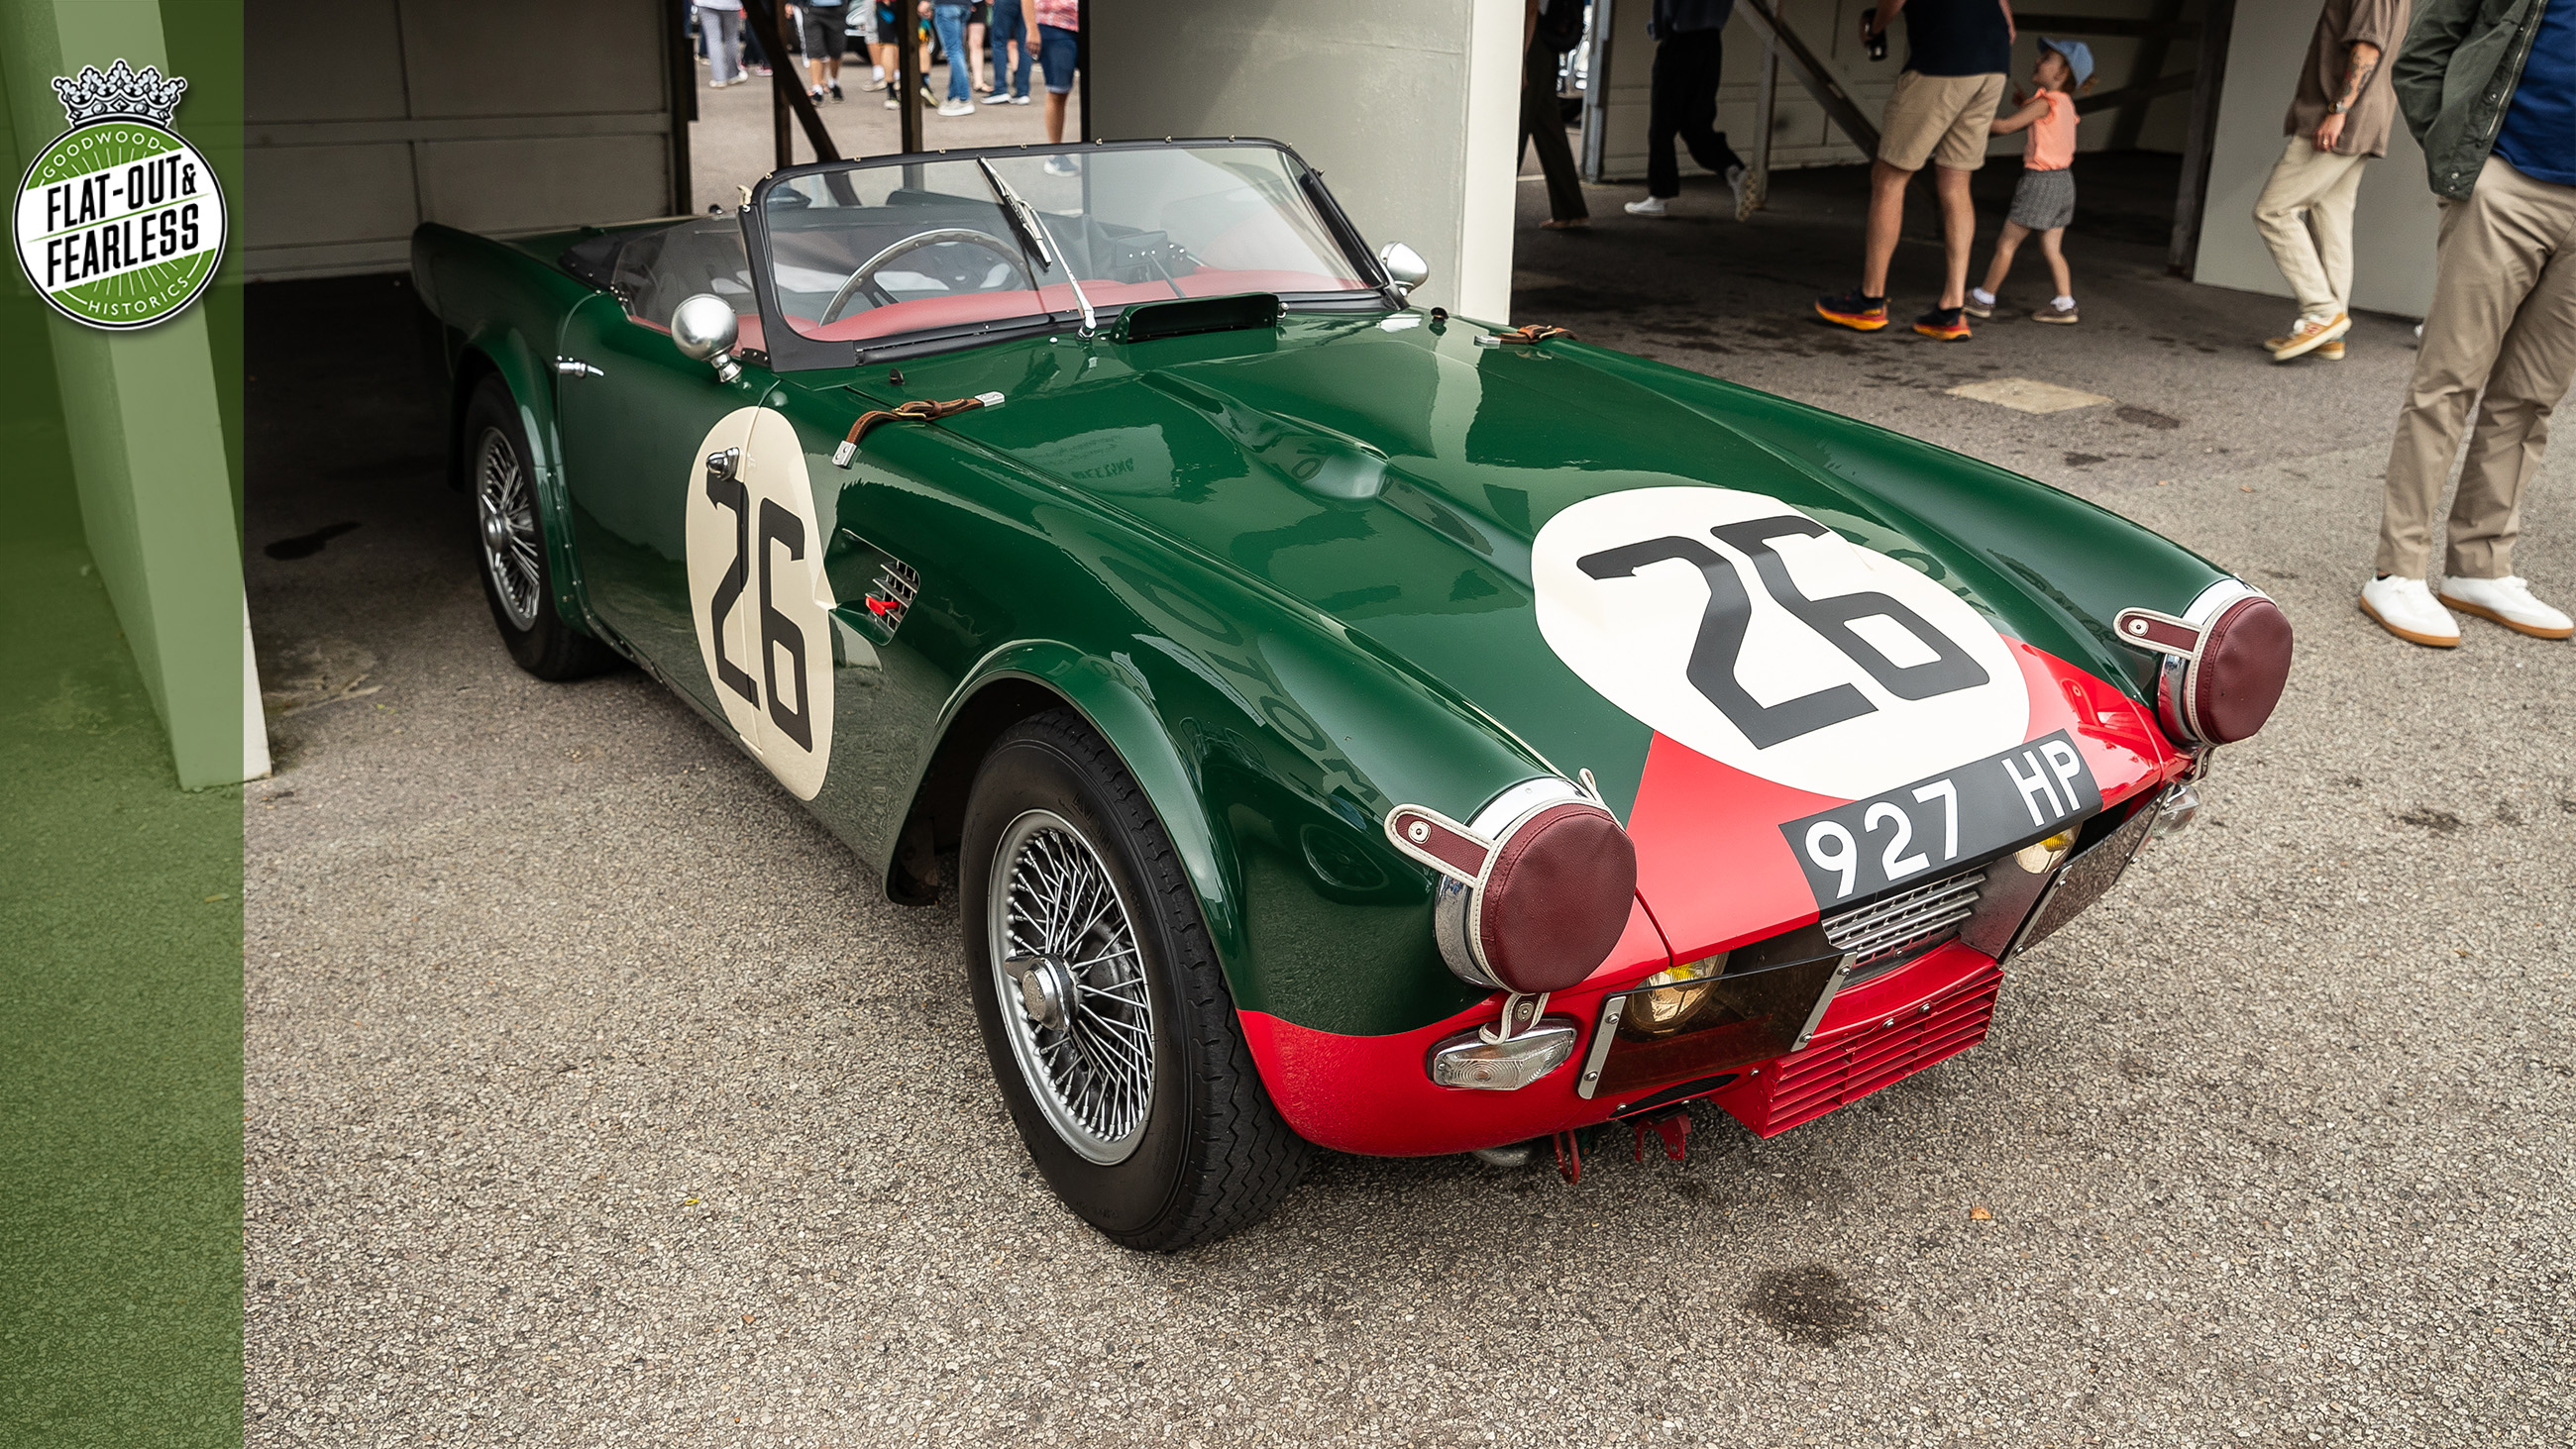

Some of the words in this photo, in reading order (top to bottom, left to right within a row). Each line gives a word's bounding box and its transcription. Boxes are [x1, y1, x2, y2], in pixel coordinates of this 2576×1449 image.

[705, 468, 812, 754] 26
[1576, 515, 1989, 750] 26
[1804, 778, 1960, 899] 927
[2001, 739, 2082, 827] HP
